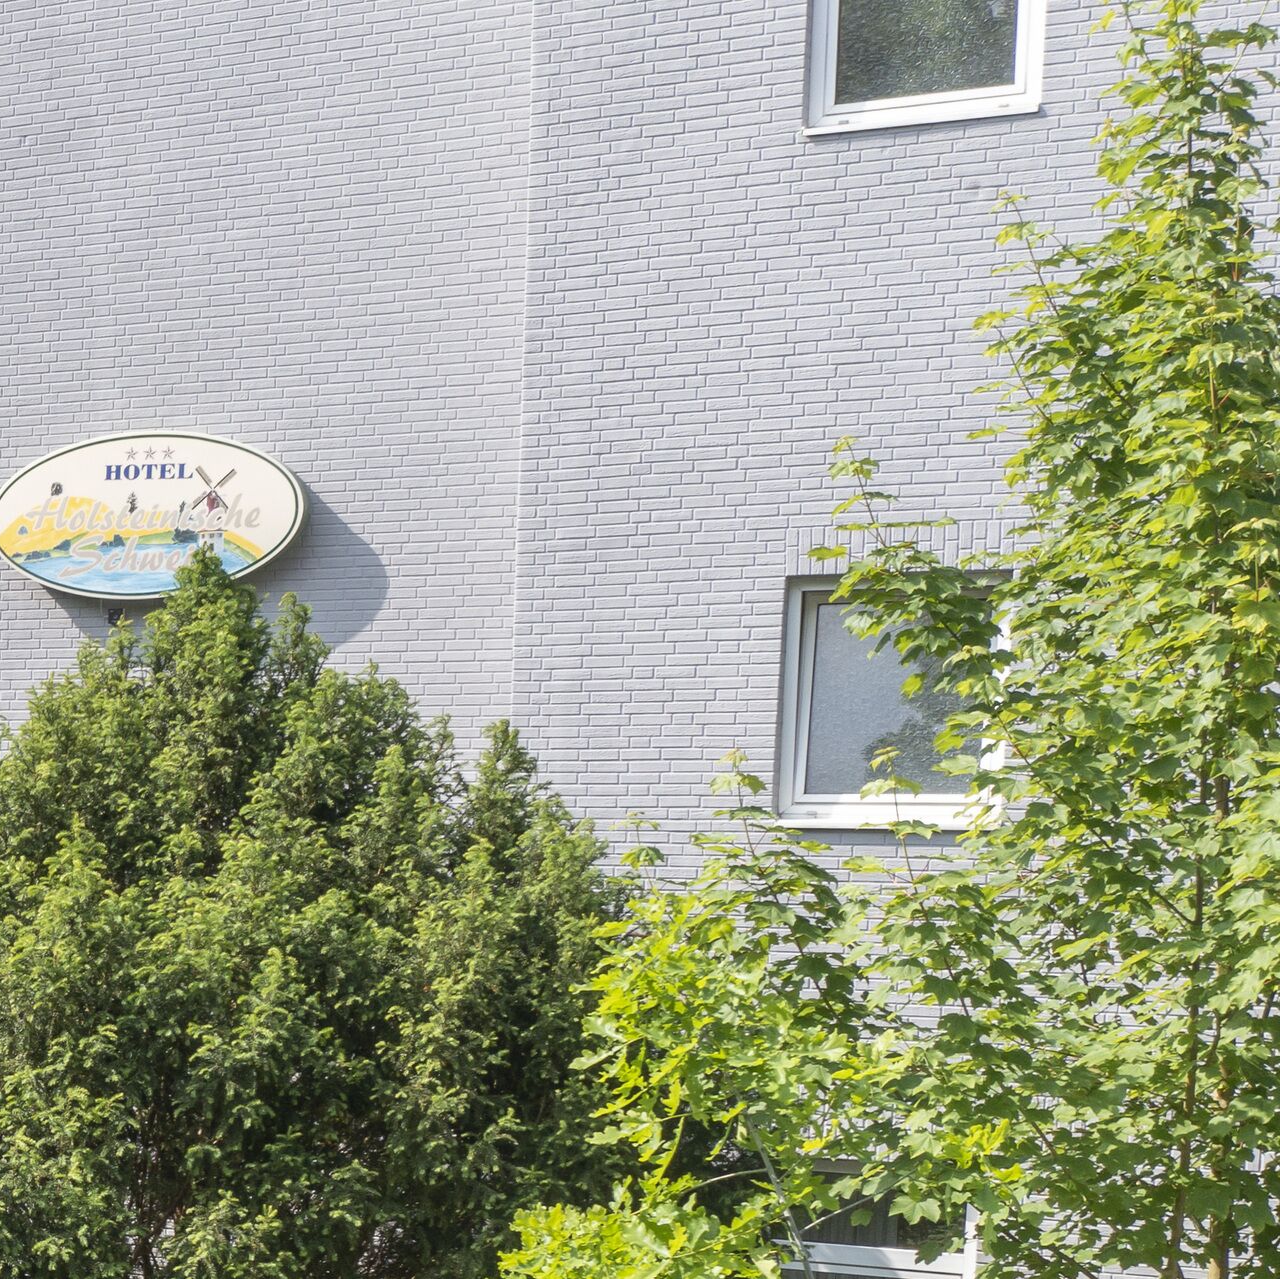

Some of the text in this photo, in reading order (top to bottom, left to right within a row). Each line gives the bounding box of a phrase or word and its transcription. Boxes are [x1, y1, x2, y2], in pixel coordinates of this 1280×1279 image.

[105, 463, 193, 481] HOTEL
[26, 493, 261, 531] Holsteinische
[59, 535, 195, 577] Schwei
